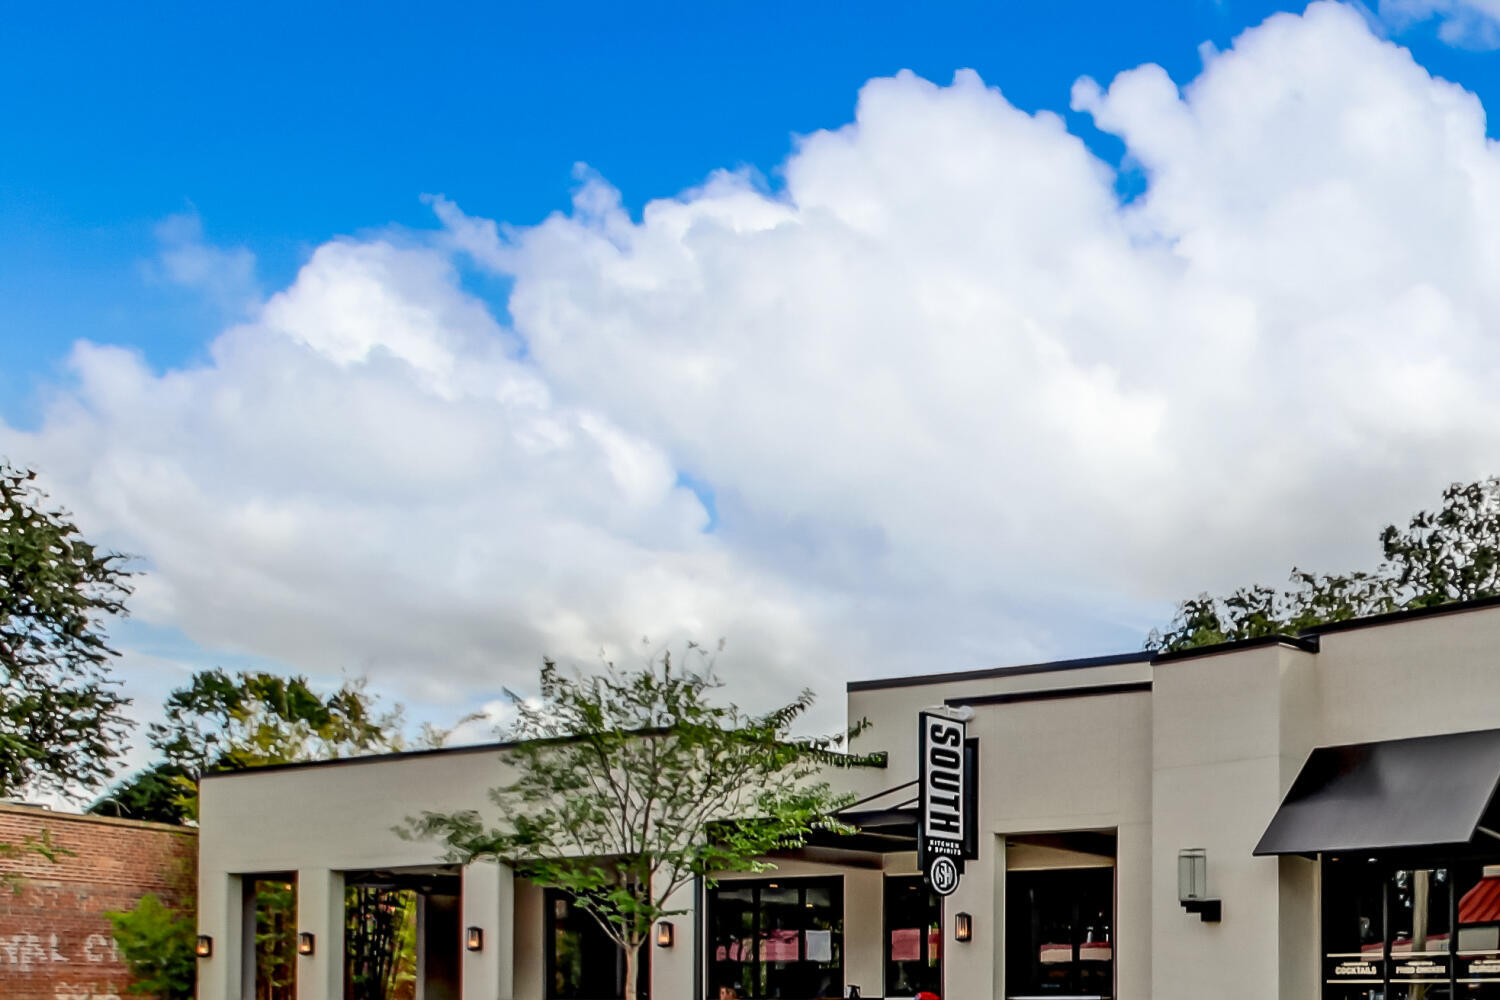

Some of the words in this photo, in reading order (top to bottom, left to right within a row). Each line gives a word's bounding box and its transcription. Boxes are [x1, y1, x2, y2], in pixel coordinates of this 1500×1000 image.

[930, 723, 961, 834] SOUTH
[929, 839, 960, 849] KITCHEN
[934, 846, 962, 856] SPIRITS
[1335, 966, 1377, 975] COCKTAILS
